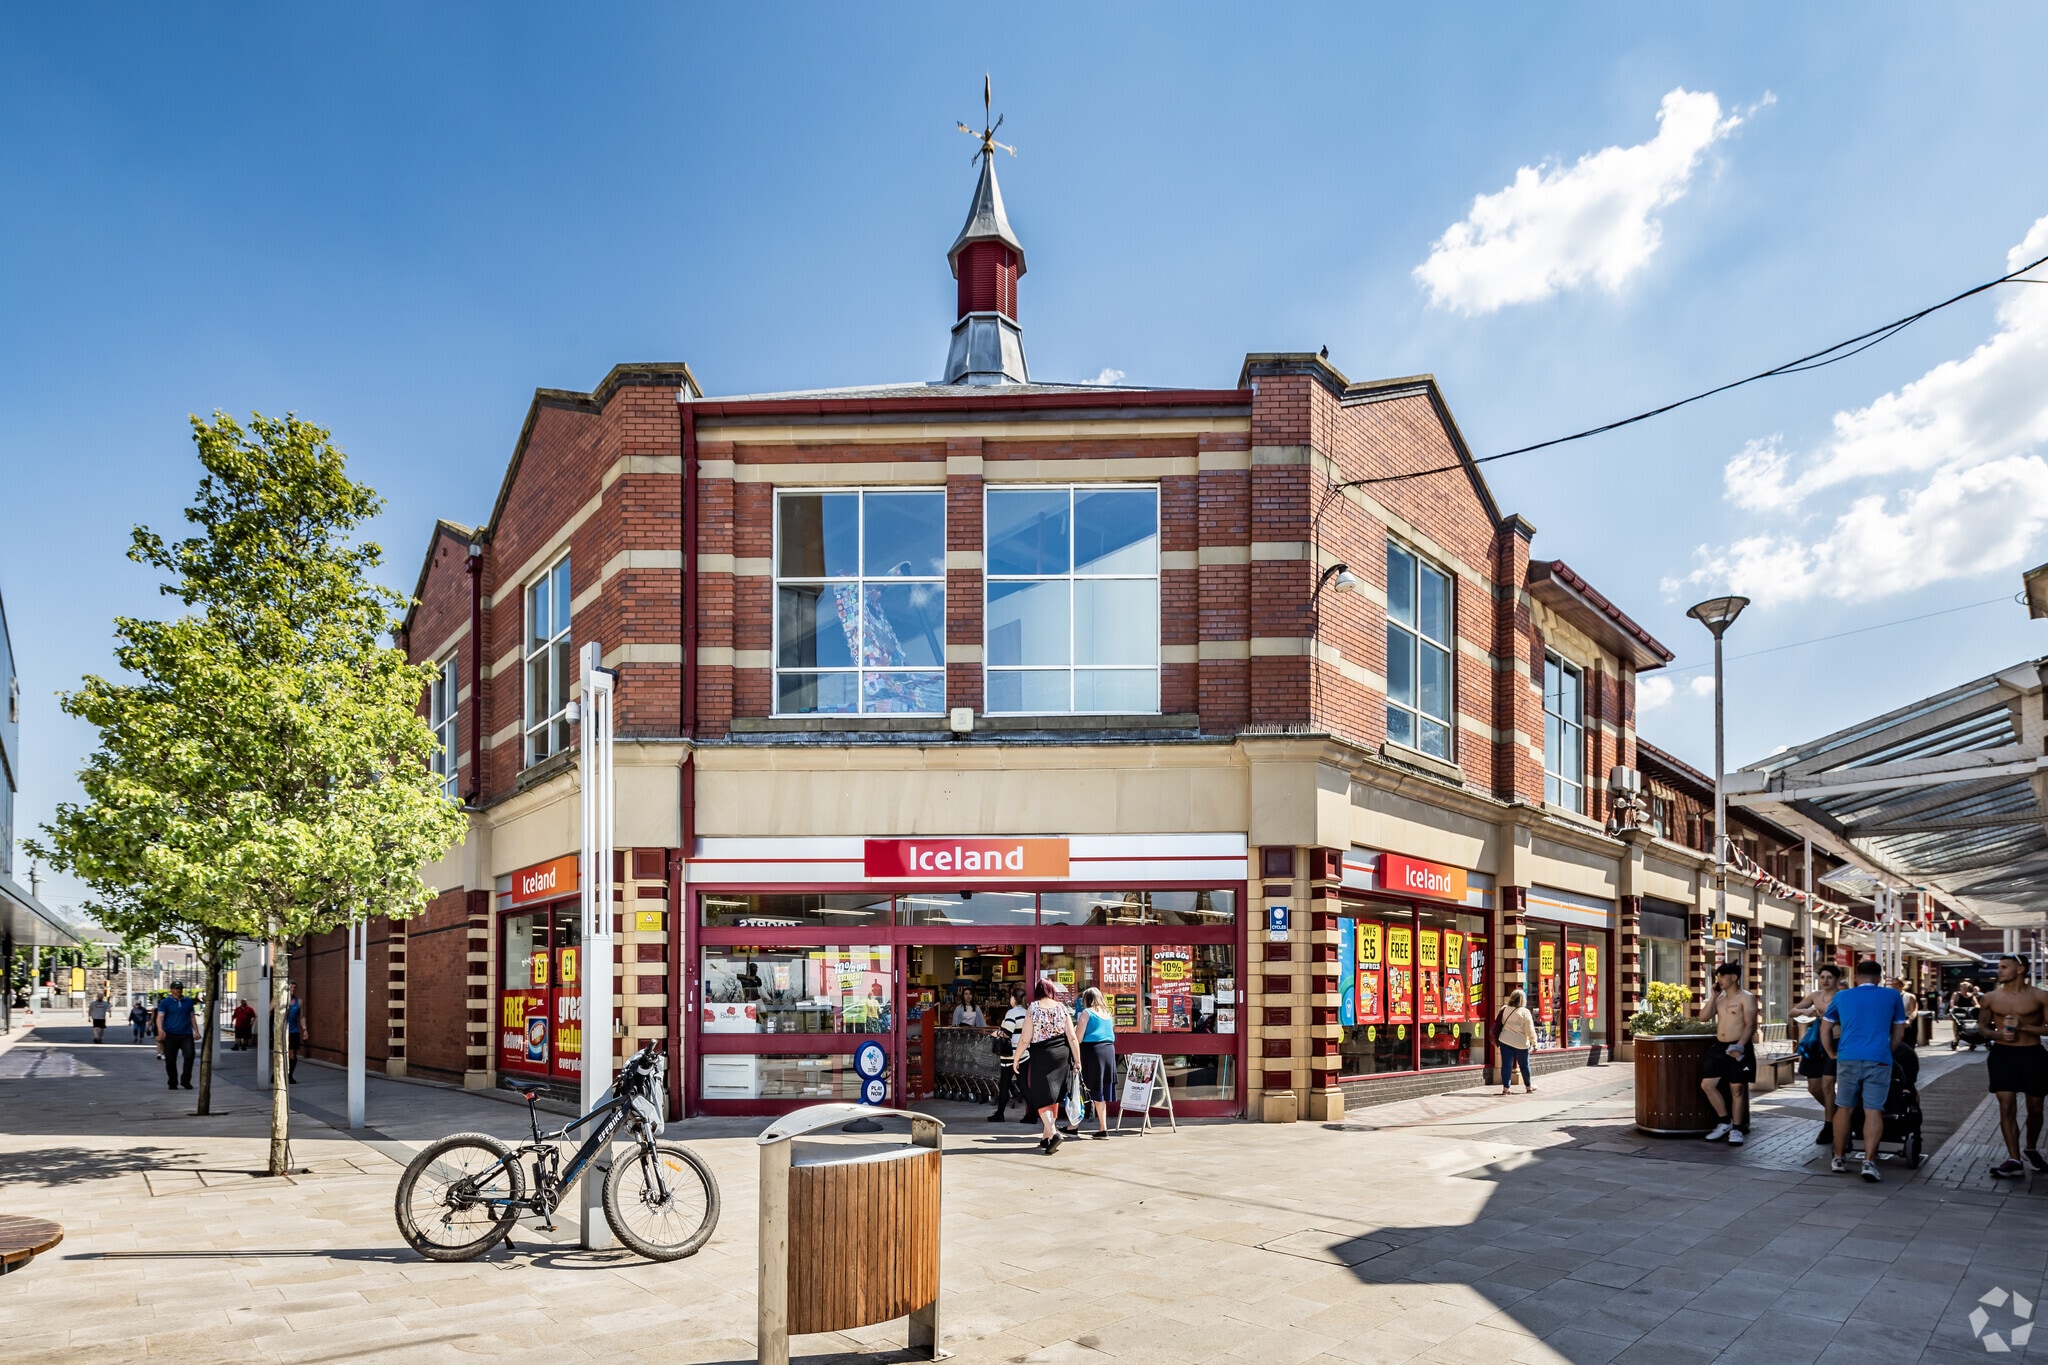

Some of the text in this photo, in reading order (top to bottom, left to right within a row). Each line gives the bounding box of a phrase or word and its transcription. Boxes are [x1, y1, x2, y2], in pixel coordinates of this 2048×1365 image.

[909, 846, 1024, 871] Iceland
[522, 867, 556, 895] Iceland
[1405, 864, 1451, 893] Iceland
[1363, 926, 1377, 937] ANY 5
[1715, 923, 1728, 938] H
[1154, 951, 1190, 960] OVER 60s
[1363, 938, 1376, 960] £5
[1390, 942, 1409, 959] FREE
[1422, 944, 1436, 961] FREE
[565, 955, 573, 975] £1
[834, 961, 868, 974] 10% OFF
[1103, 956, 1138, 974] FREE
[1162, 962, 1182, 973] 10%
[1471, 950, 1485, 969] 10%
[1542, 956, 1553, 970] FREE
[1569, 957, 1580, 974] 10%
[1103, 973, 1137, 983] DELIVERY
[1472, 967, 1482, 985] OFF
[1570, 972, 1579, 987] OFF
[504, 996, 525, 1028] FREE
[558, 996, 582, 1024] grea
[503, 1031, 524, 1051] delivery
[558, 1024, 582, 1053] valu
[597, 1110, 624, 1143] EFFBIKE
